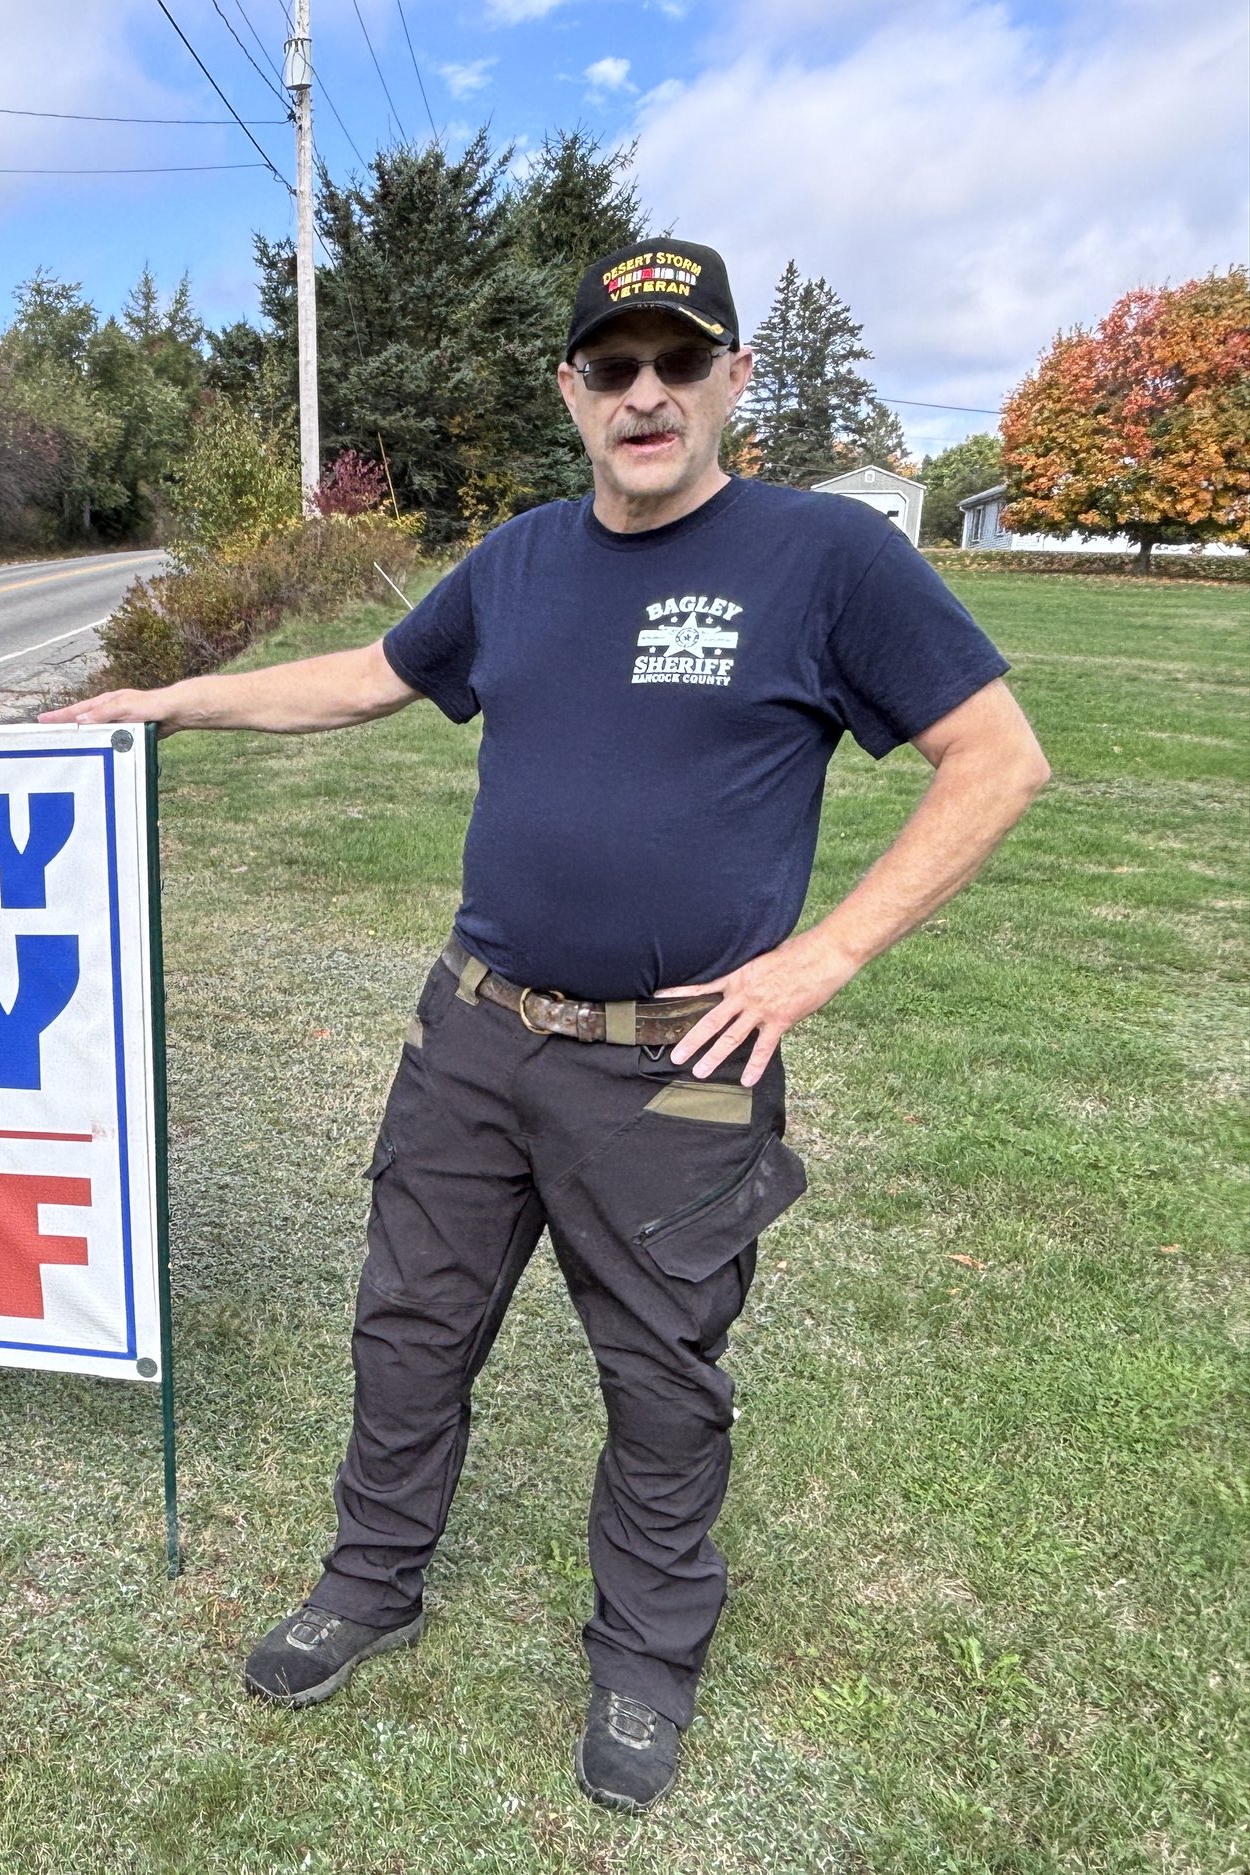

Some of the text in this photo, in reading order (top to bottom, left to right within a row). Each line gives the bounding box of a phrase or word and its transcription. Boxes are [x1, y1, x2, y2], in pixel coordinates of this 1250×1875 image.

[602, 252, 702, 286] DESERT STORM
[610, 280, 691, 302] VETERAN
[646, 596, 743, 621] BAGLEY
[633, 655, 734, 676] SHERIFF
[631, 673, 731, 686] HANCOCK COUNTY
